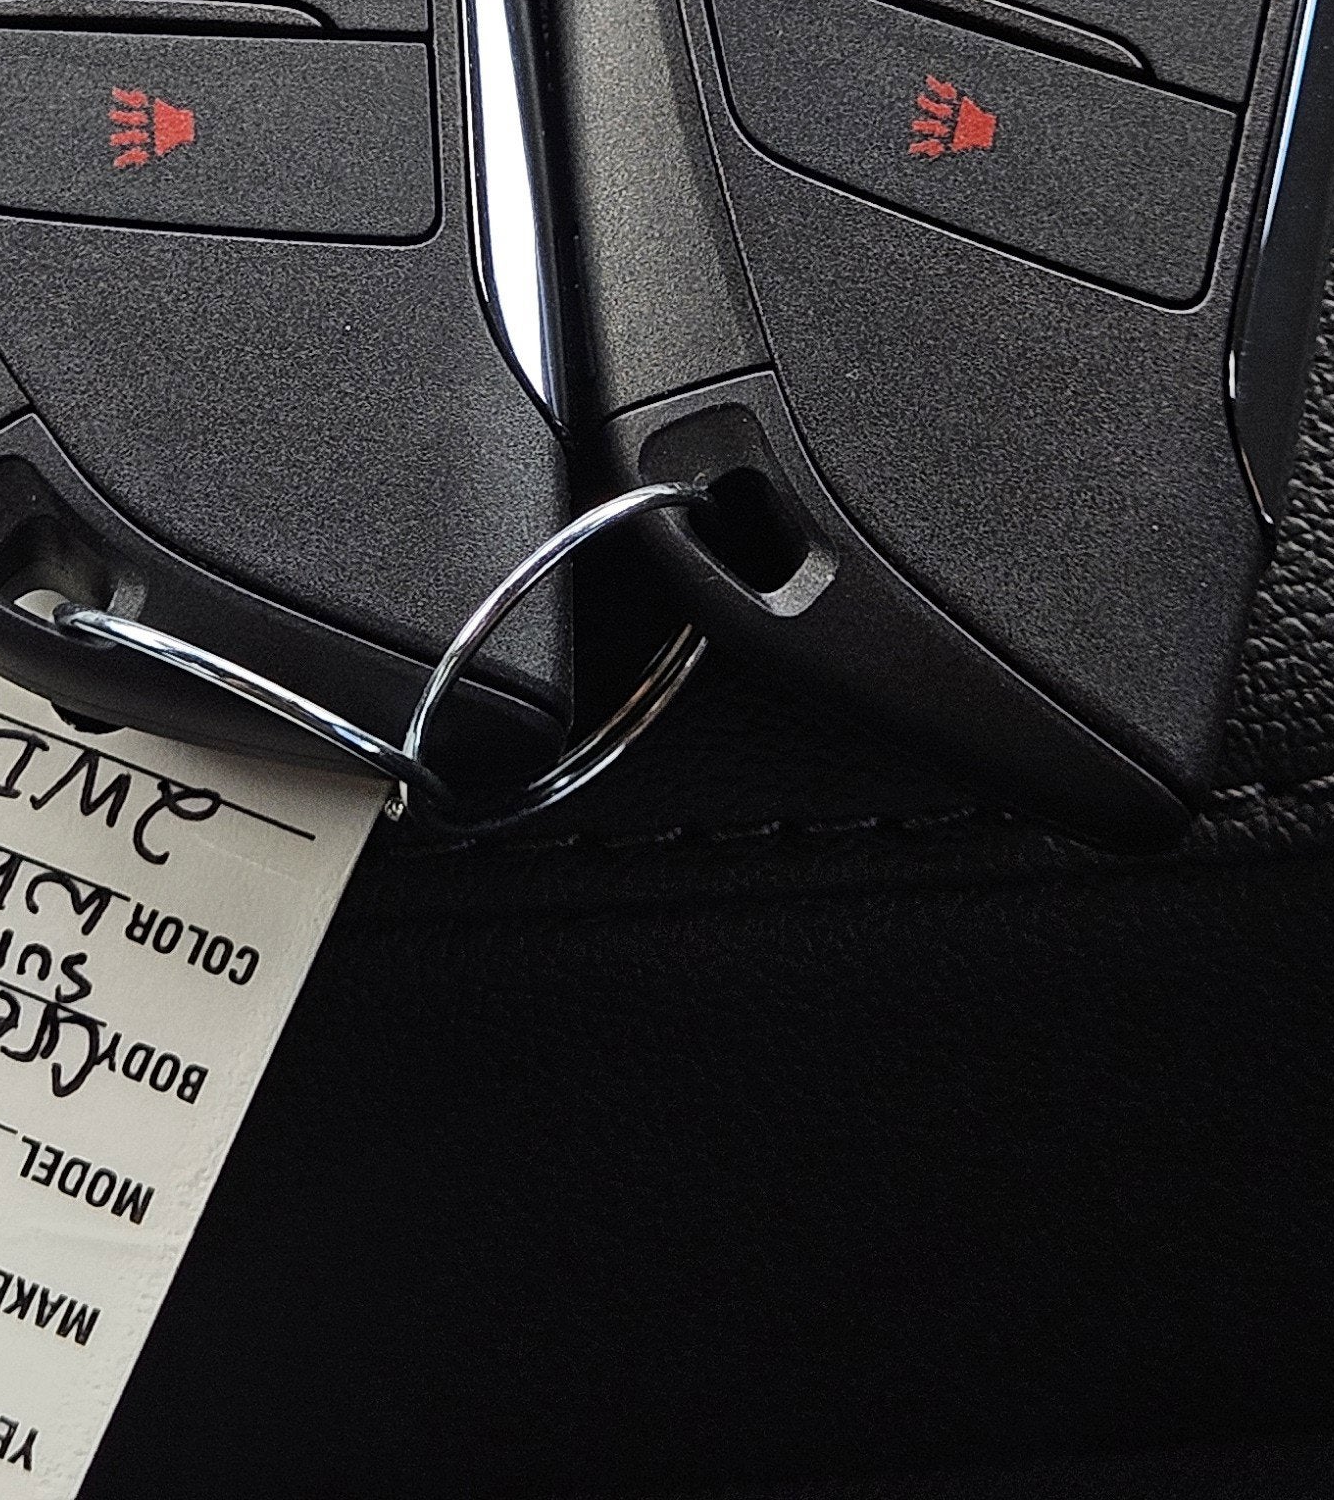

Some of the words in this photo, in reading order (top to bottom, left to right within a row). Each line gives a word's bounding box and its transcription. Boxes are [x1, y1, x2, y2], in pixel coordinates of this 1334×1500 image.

[124, 902, 261, 986] COLOR
[96, 1032, 209, 1105] BODY
[19, 1134, 155, 1224] MODEL
